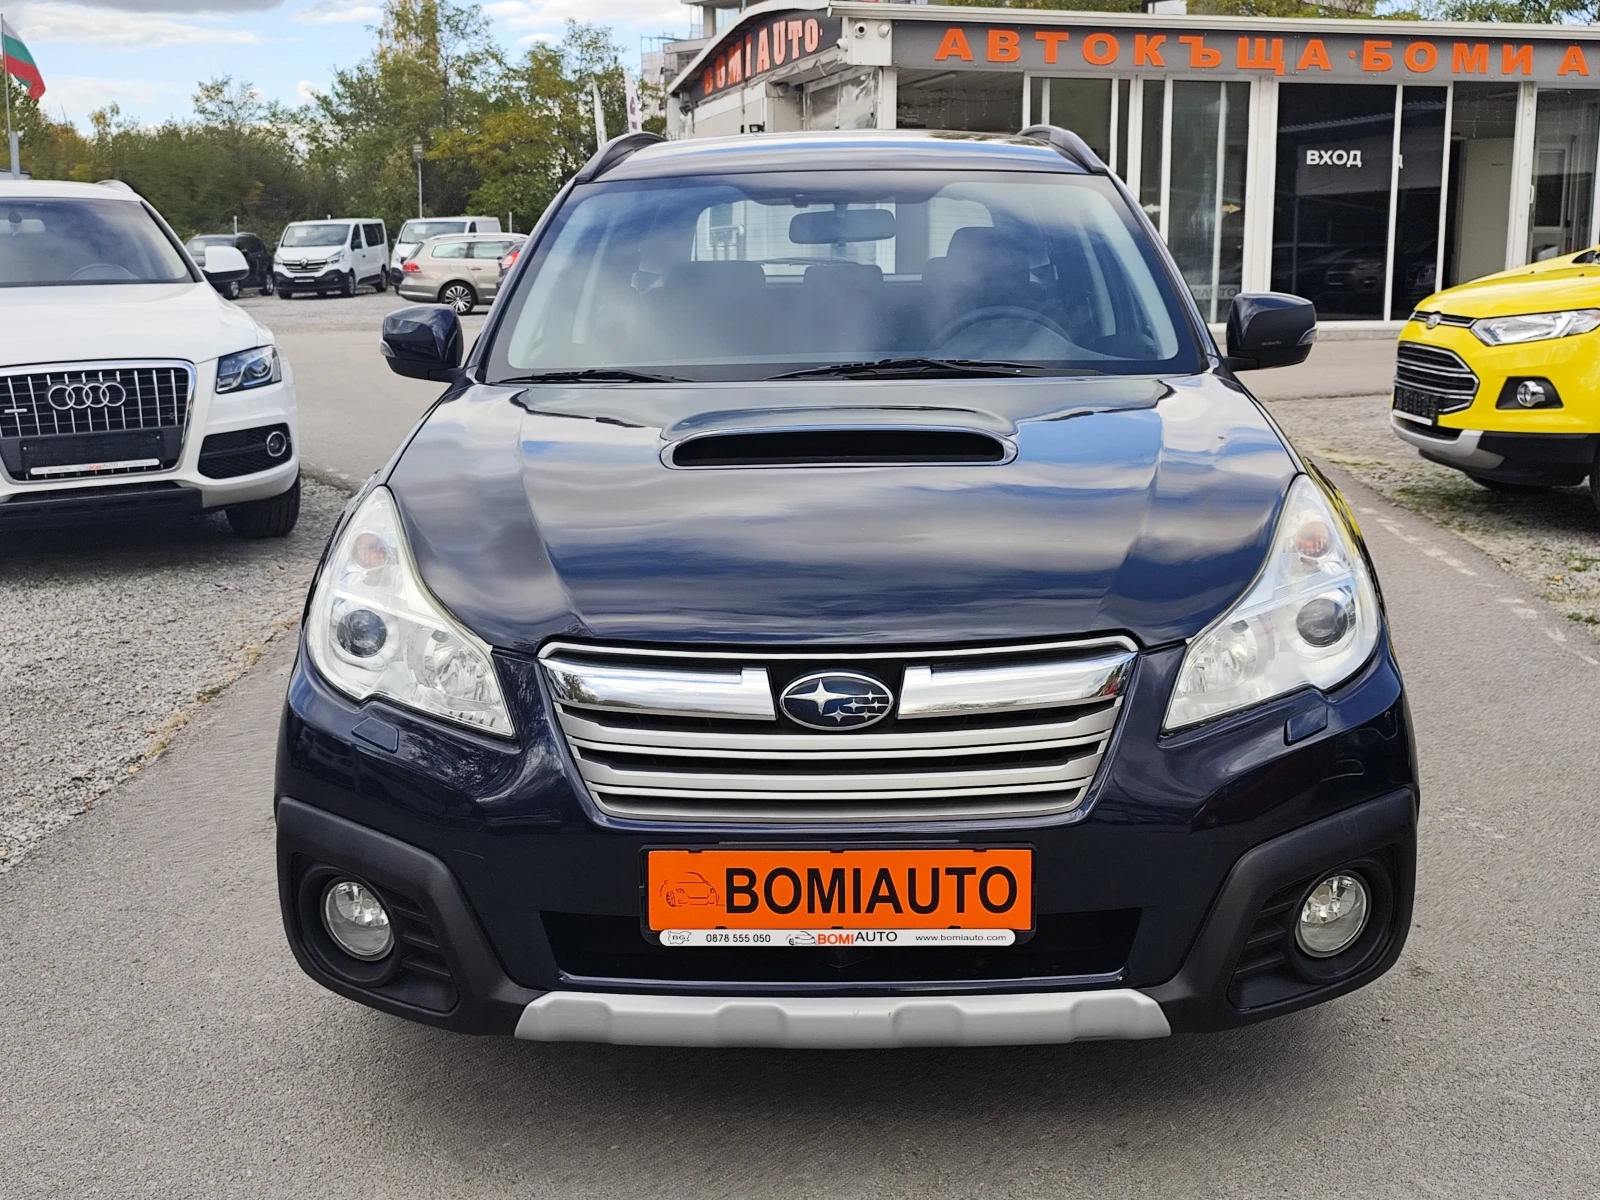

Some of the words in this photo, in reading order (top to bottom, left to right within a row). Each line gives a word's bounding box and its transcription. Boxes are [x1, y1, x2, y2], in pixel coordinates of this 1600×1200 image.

[1556, 44, 1600, 77] А
[1305, 149, 1363, 168] ВХОД
[725, 865, 1018, 915] BOMIAUTO
[705, 933, 730, 943] 0878
[732, 933, 750, 943] 555
[752, 933, 771, 943] 050
[915, 933, 1007, 942] www.bomiauto.com
